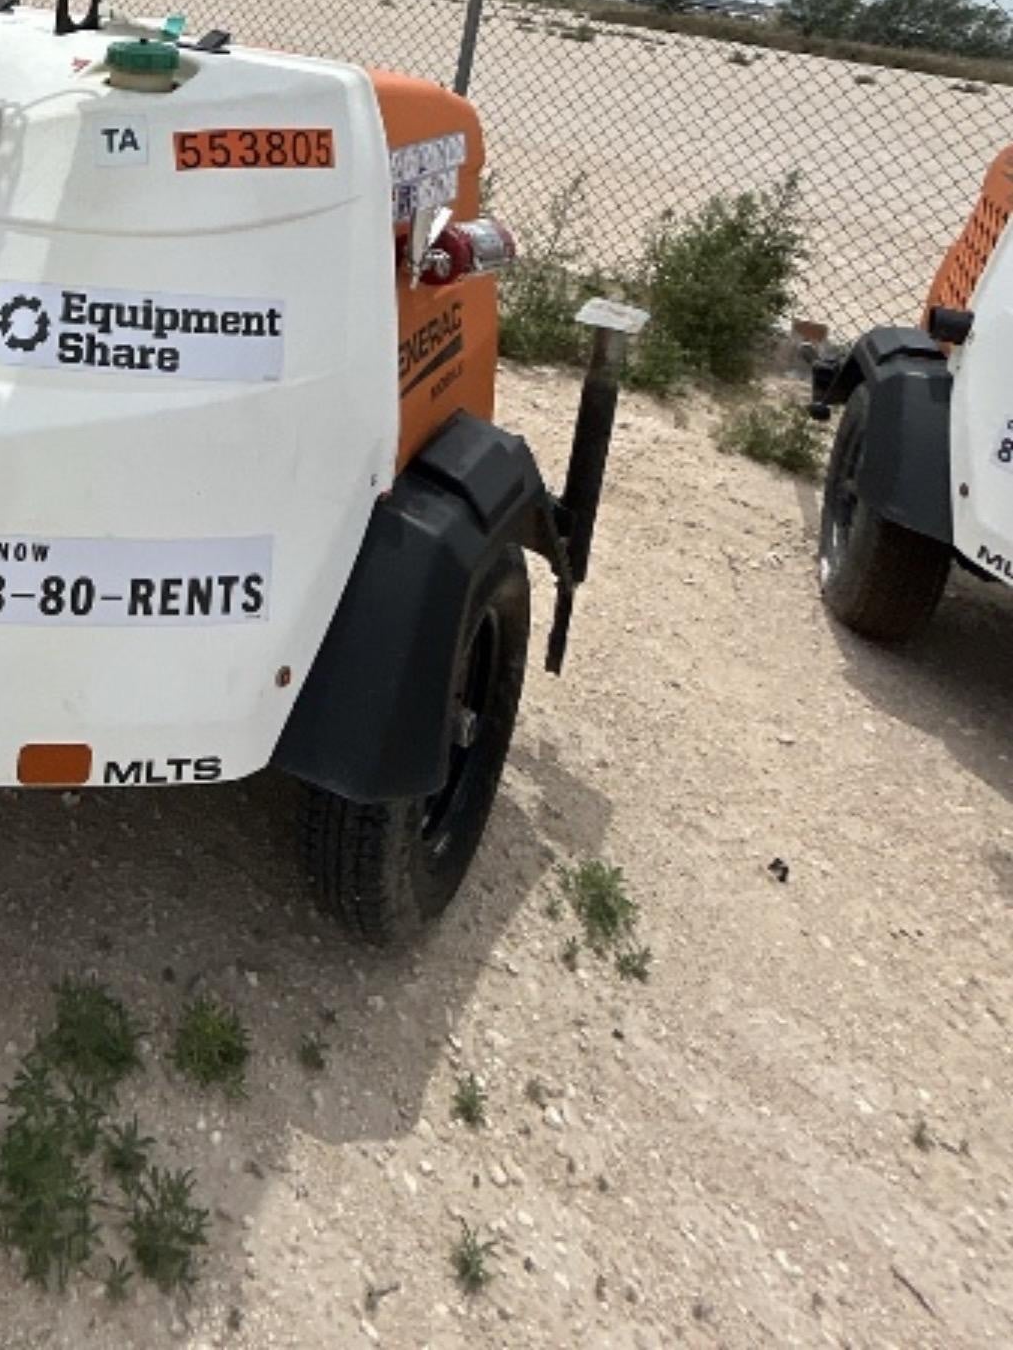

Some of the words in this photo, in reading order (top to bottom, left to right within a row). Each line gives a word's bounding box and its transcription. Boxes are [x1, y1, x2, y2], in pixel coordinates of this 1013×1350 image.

[101, 127, 140, 154] TA
[179, 130, 332, 170] 553805
[60, 290, 282, 340] Equipment
[57, 332, 180, 373] Share
[103, 756, 222, 784] MLTS
